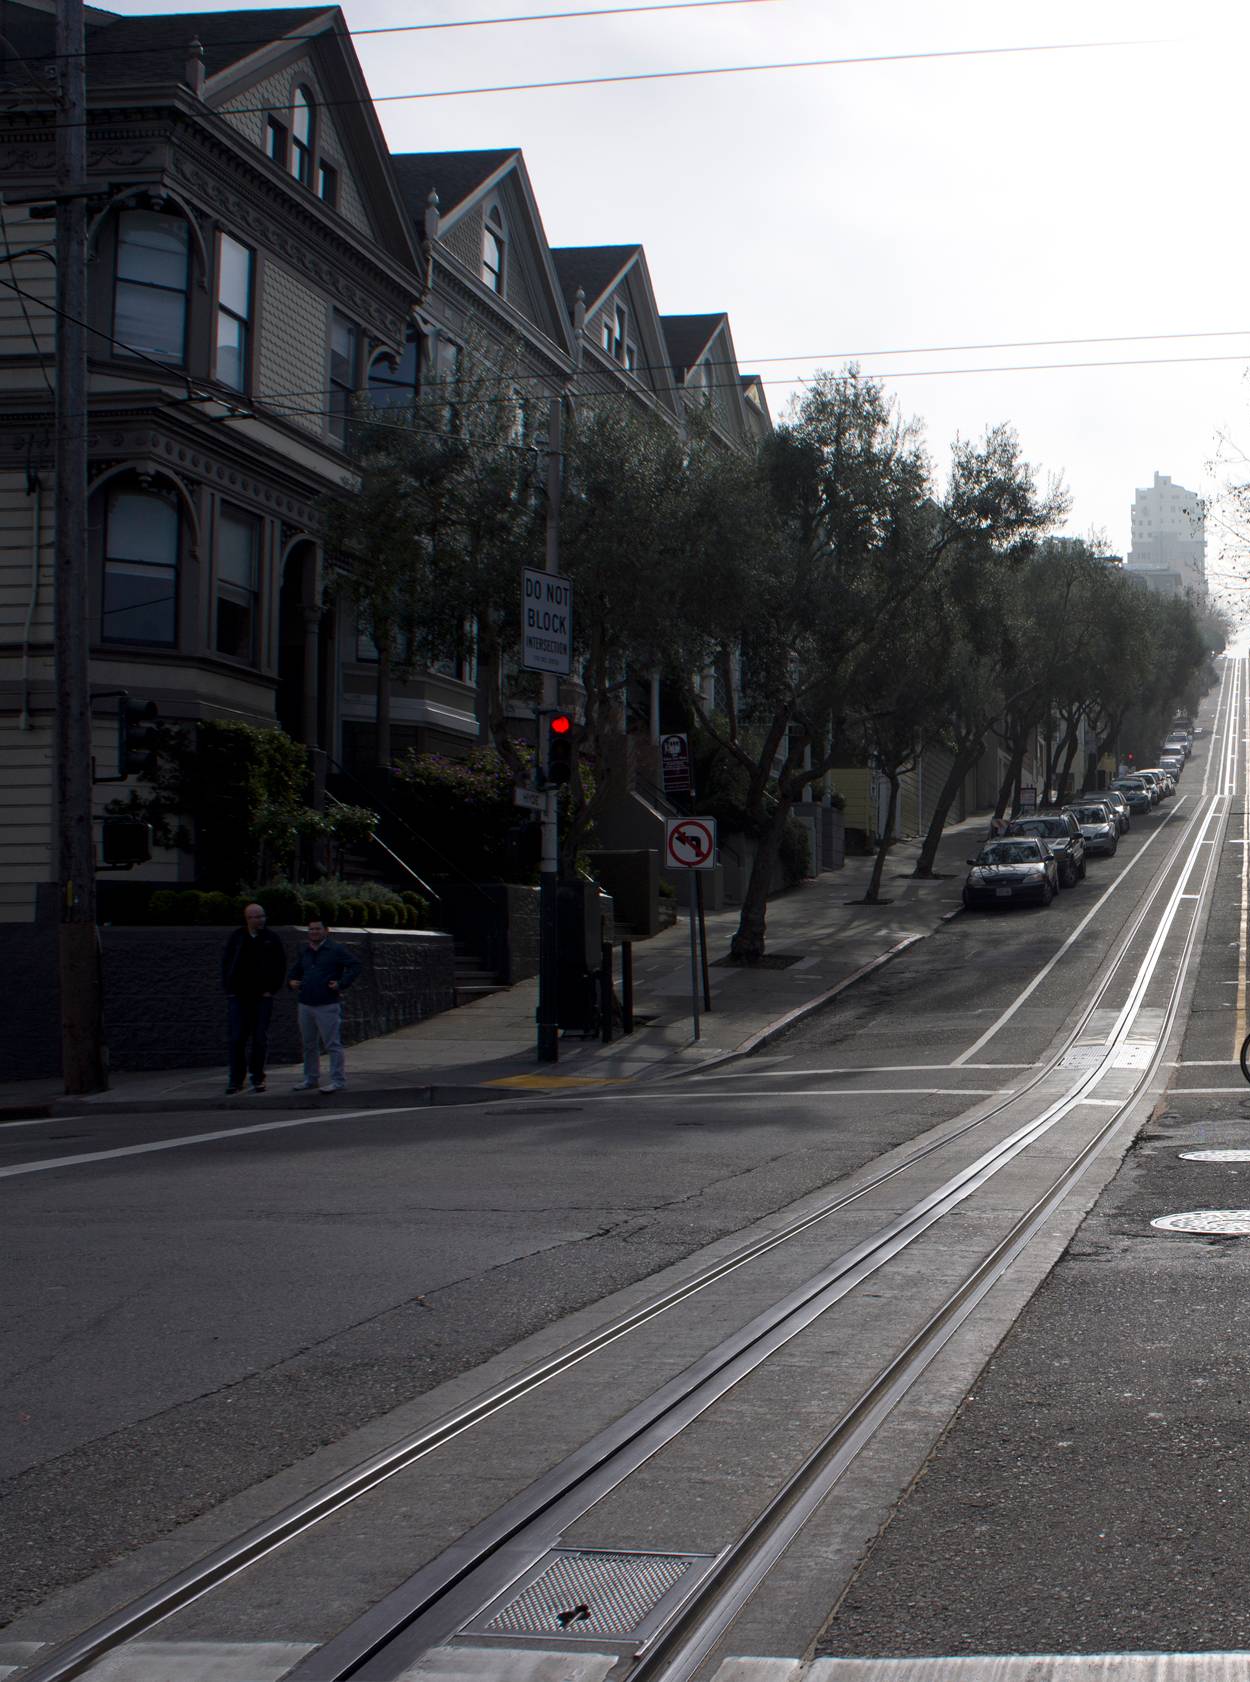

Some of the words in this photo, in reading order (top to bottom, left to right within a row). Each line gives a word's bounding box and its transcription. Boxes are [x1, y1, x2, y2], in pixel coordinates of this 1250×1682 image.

[525, 578, 541, 600] DO
[547, 583, 569, 607] NOT
[528, 608, 567, 635] BLOCK
[526, 636, 568, 656] INTERSECTION
